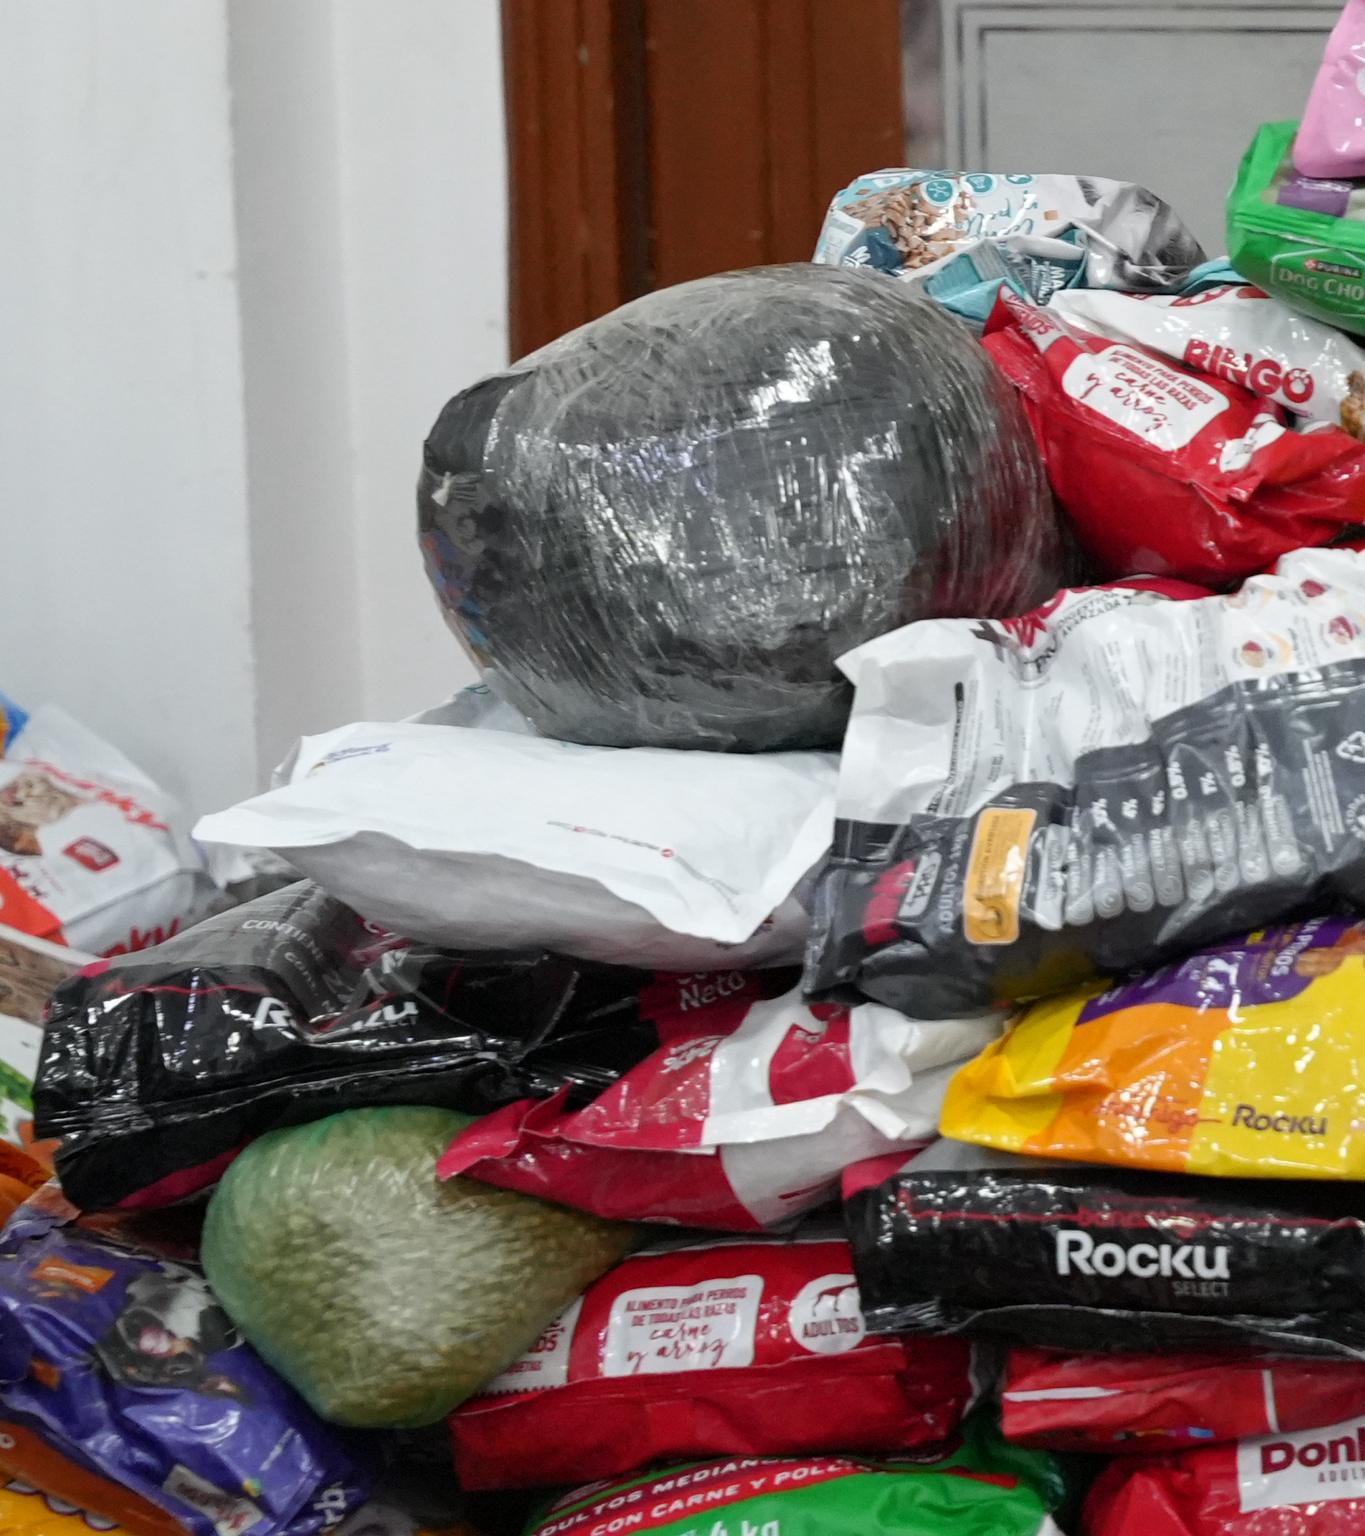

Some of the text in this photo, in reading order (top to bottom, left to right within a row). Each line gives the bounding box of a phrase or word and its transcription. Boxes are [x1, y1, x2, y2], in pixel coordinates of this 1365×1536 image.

[1278, 267, 1318, 291] DOG
[625, 1297, 678, 1313] ALIMENTO
[705, 1286, 748, 1302] PERROS
[1171, 1280, 1232, 1298] SELECT
[631, 1313, 647, 1326] DE
[649, 1319, 712, 1341] carne
[801, 1315, 861, 1340] ADULTOS
[534, 1459, 760, 1536] DULTOS MEDIAN
[589, 1511, 645, 1536] CON
[650, 1483, 741, 1519] CARNE
[749, 1477, 768, 1491] Y
